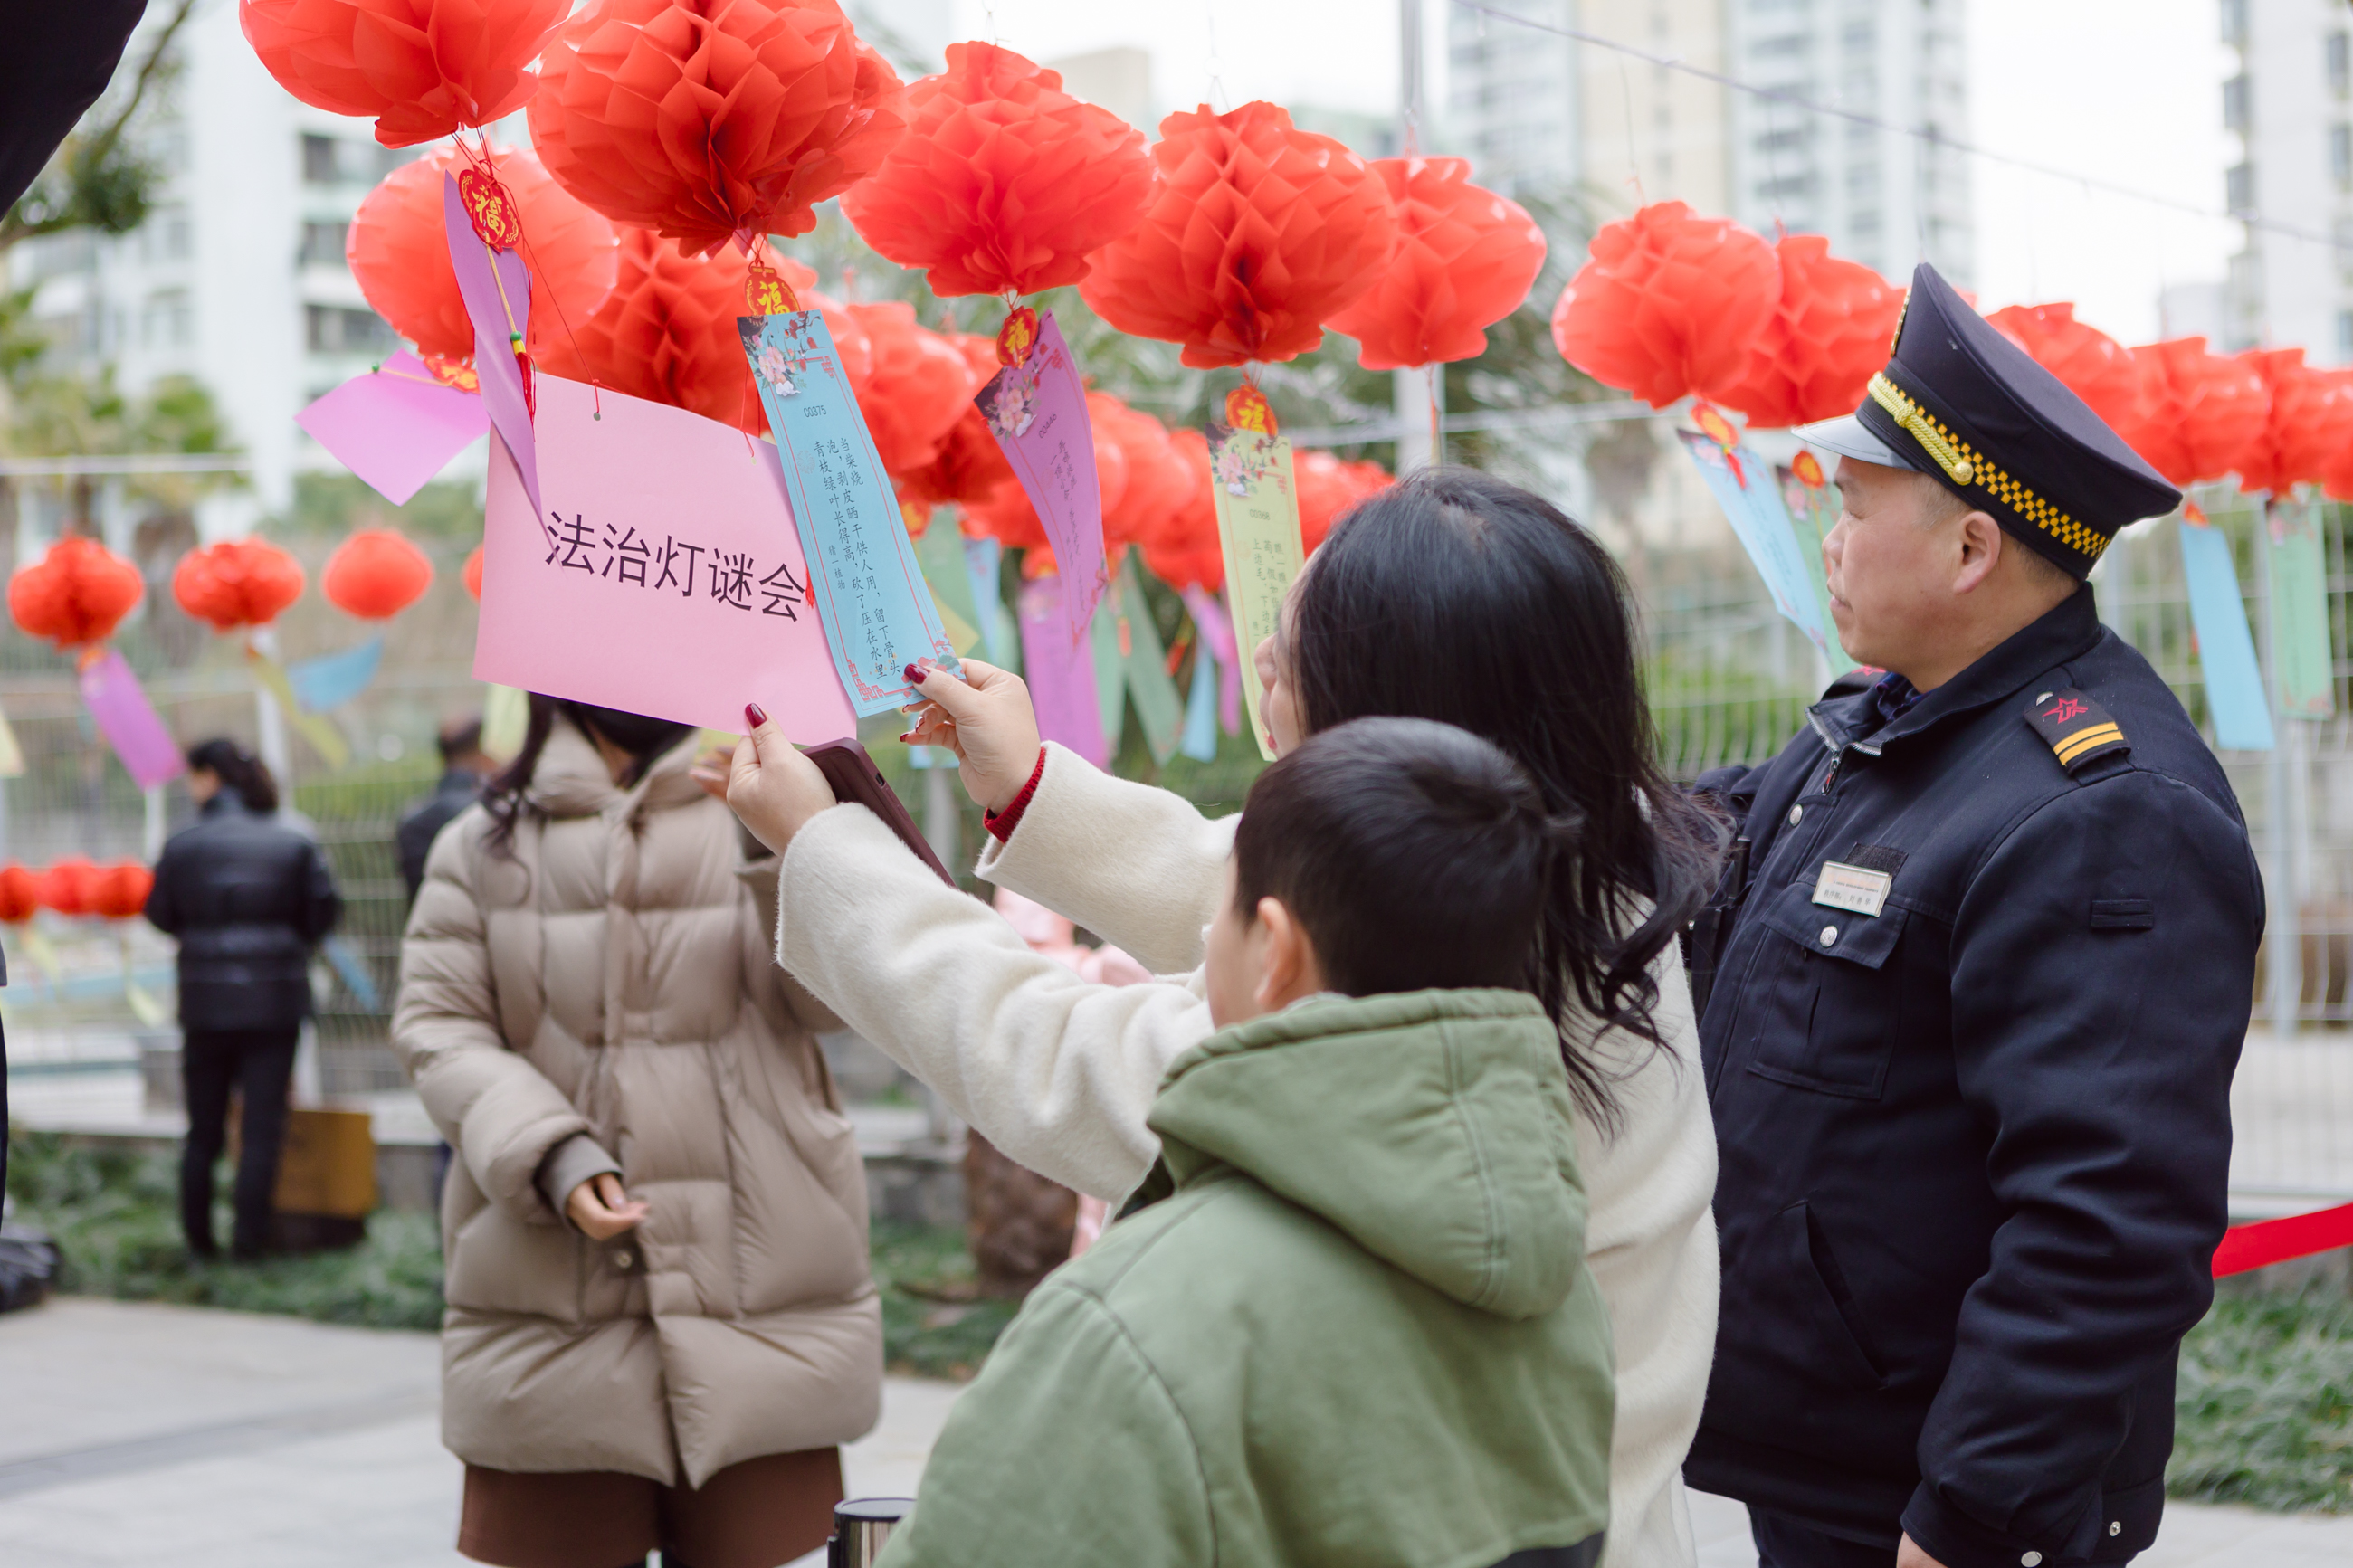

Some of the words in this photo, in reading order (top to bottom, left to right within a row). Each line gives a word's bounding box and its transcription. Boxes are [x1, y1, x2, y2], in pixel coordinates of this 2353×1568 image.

[471, 184, 506, 238] 福
[757, 280, 791, 316] 福
[1005, 316, 1030, 354] 福
[803, 405, 827, 417] C0375
[1039, 413, 1057, 439] C0446
[1237, 398, 1267, 433] 福
[840, 437, 863, 486] 当柴烧
[544, 510, 805, 622] 法治灯谜会
[828, 545, 845, 590] 猜一植物
